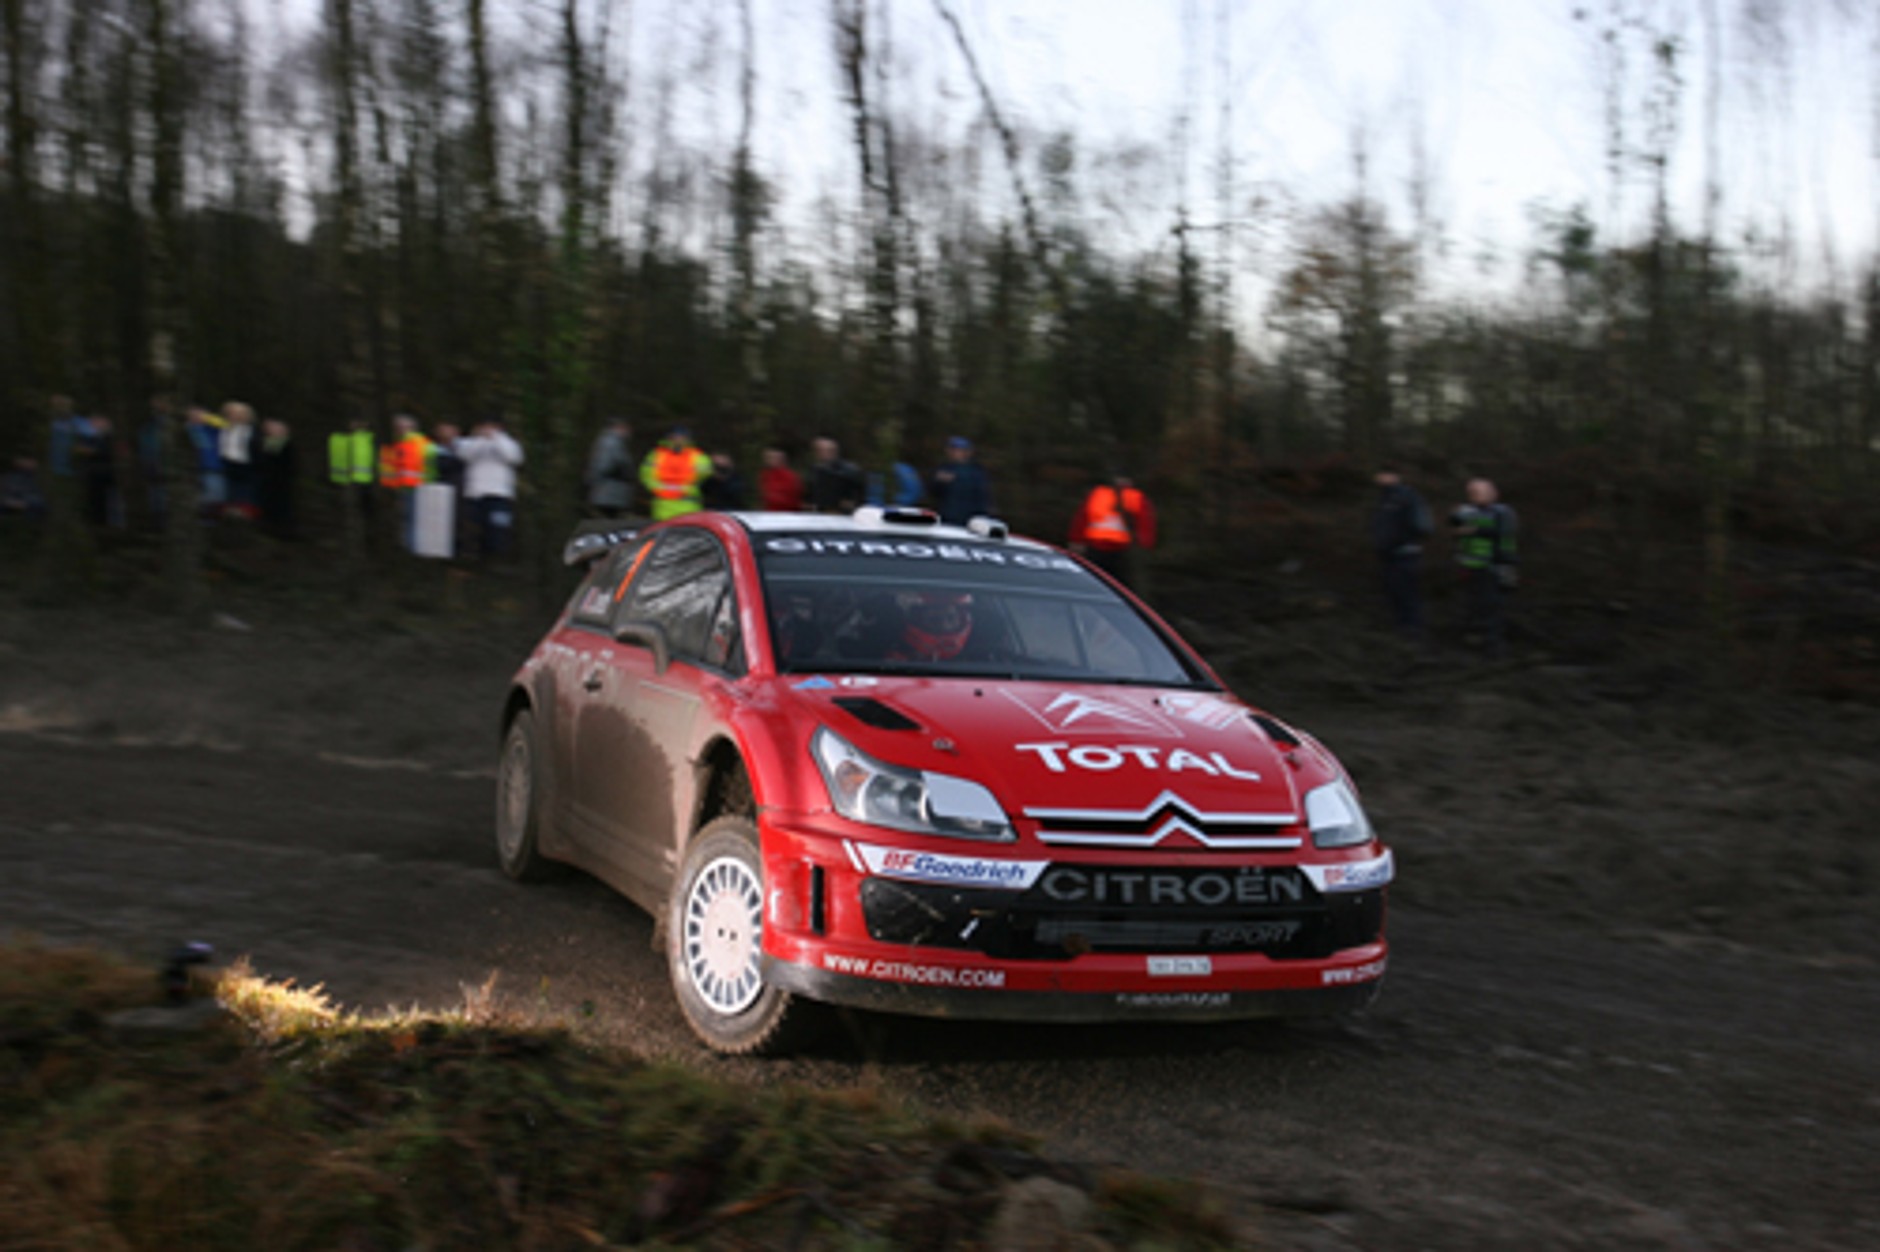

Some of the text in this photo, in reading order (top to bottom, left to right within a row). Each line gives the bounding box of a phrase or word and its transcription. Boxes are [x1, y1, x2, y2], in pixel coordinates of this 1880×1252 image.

[1015, 742, 1261, 782] TOTAL
[882, 852, 1027, 880] BFGoodrich
[1041, 866, 1302, 902] CITROËN
[823, 955, 1006, 986] WWW.CITROEN.COM
